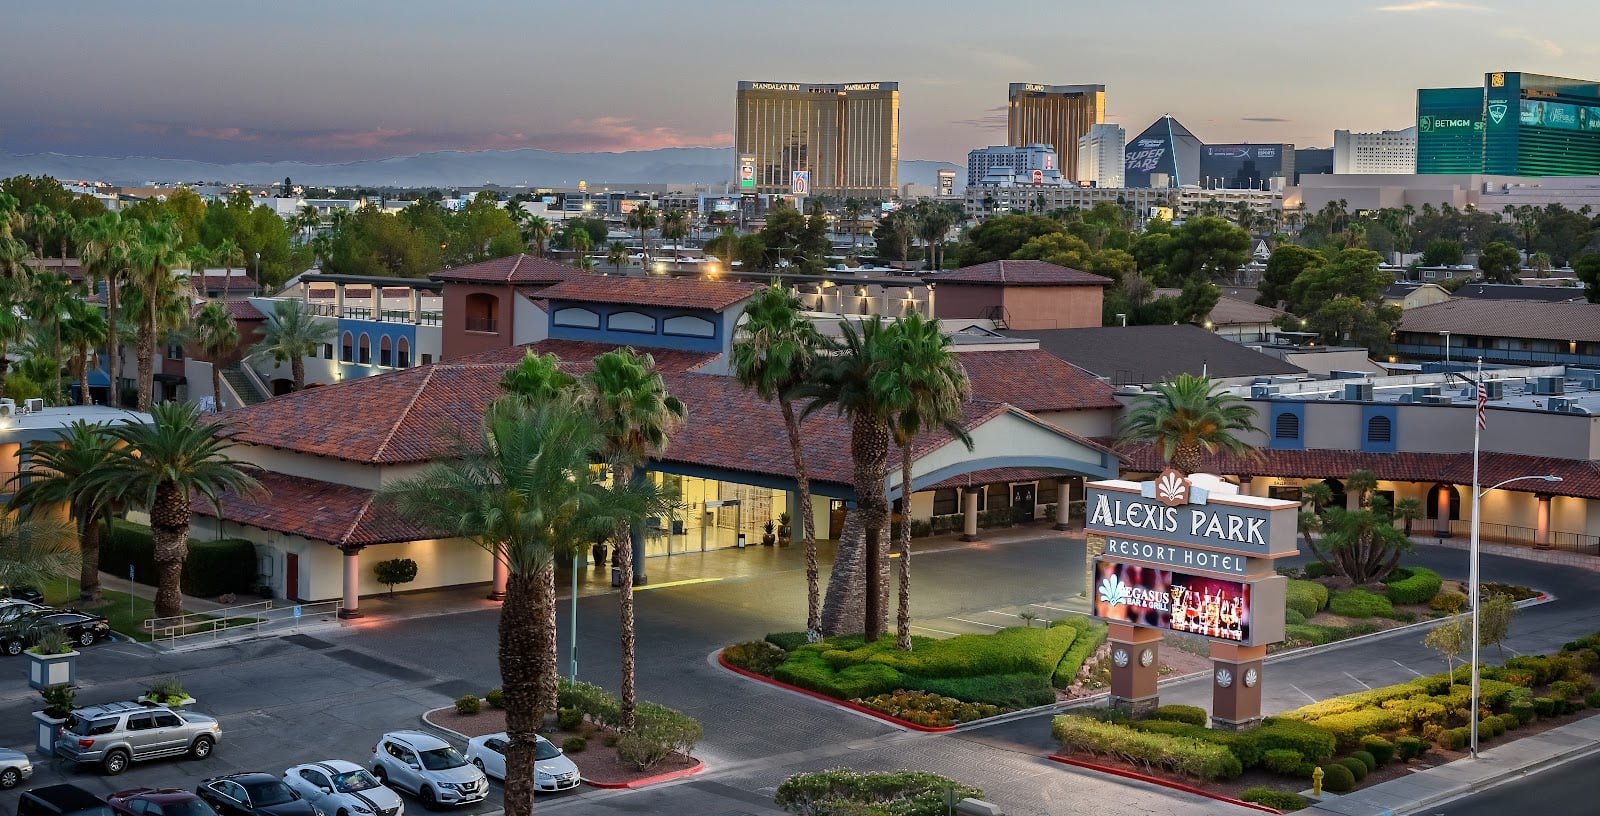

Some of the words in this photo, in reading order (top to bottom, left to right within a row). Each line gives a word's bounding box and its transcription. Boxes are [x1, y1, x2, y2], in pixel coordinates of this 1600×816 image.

[1435, 119, 1470, 128] BETMGM
[1126, 148, 1165, 160] SUPER
[1125, 158, 1159, 169] TARS
[796, 172, 804, 192] 6
[1090, 494, 1178, 532] ALEXIS
[1190, 510, 1266, 545] PARK
[1109, 539, 1176, 561] RESORT
[1184, 550, 1242, 572] HOTEL
[1127, 598, 1141, 606] BAR
[1149, 602, 1168, 611] GRILL
